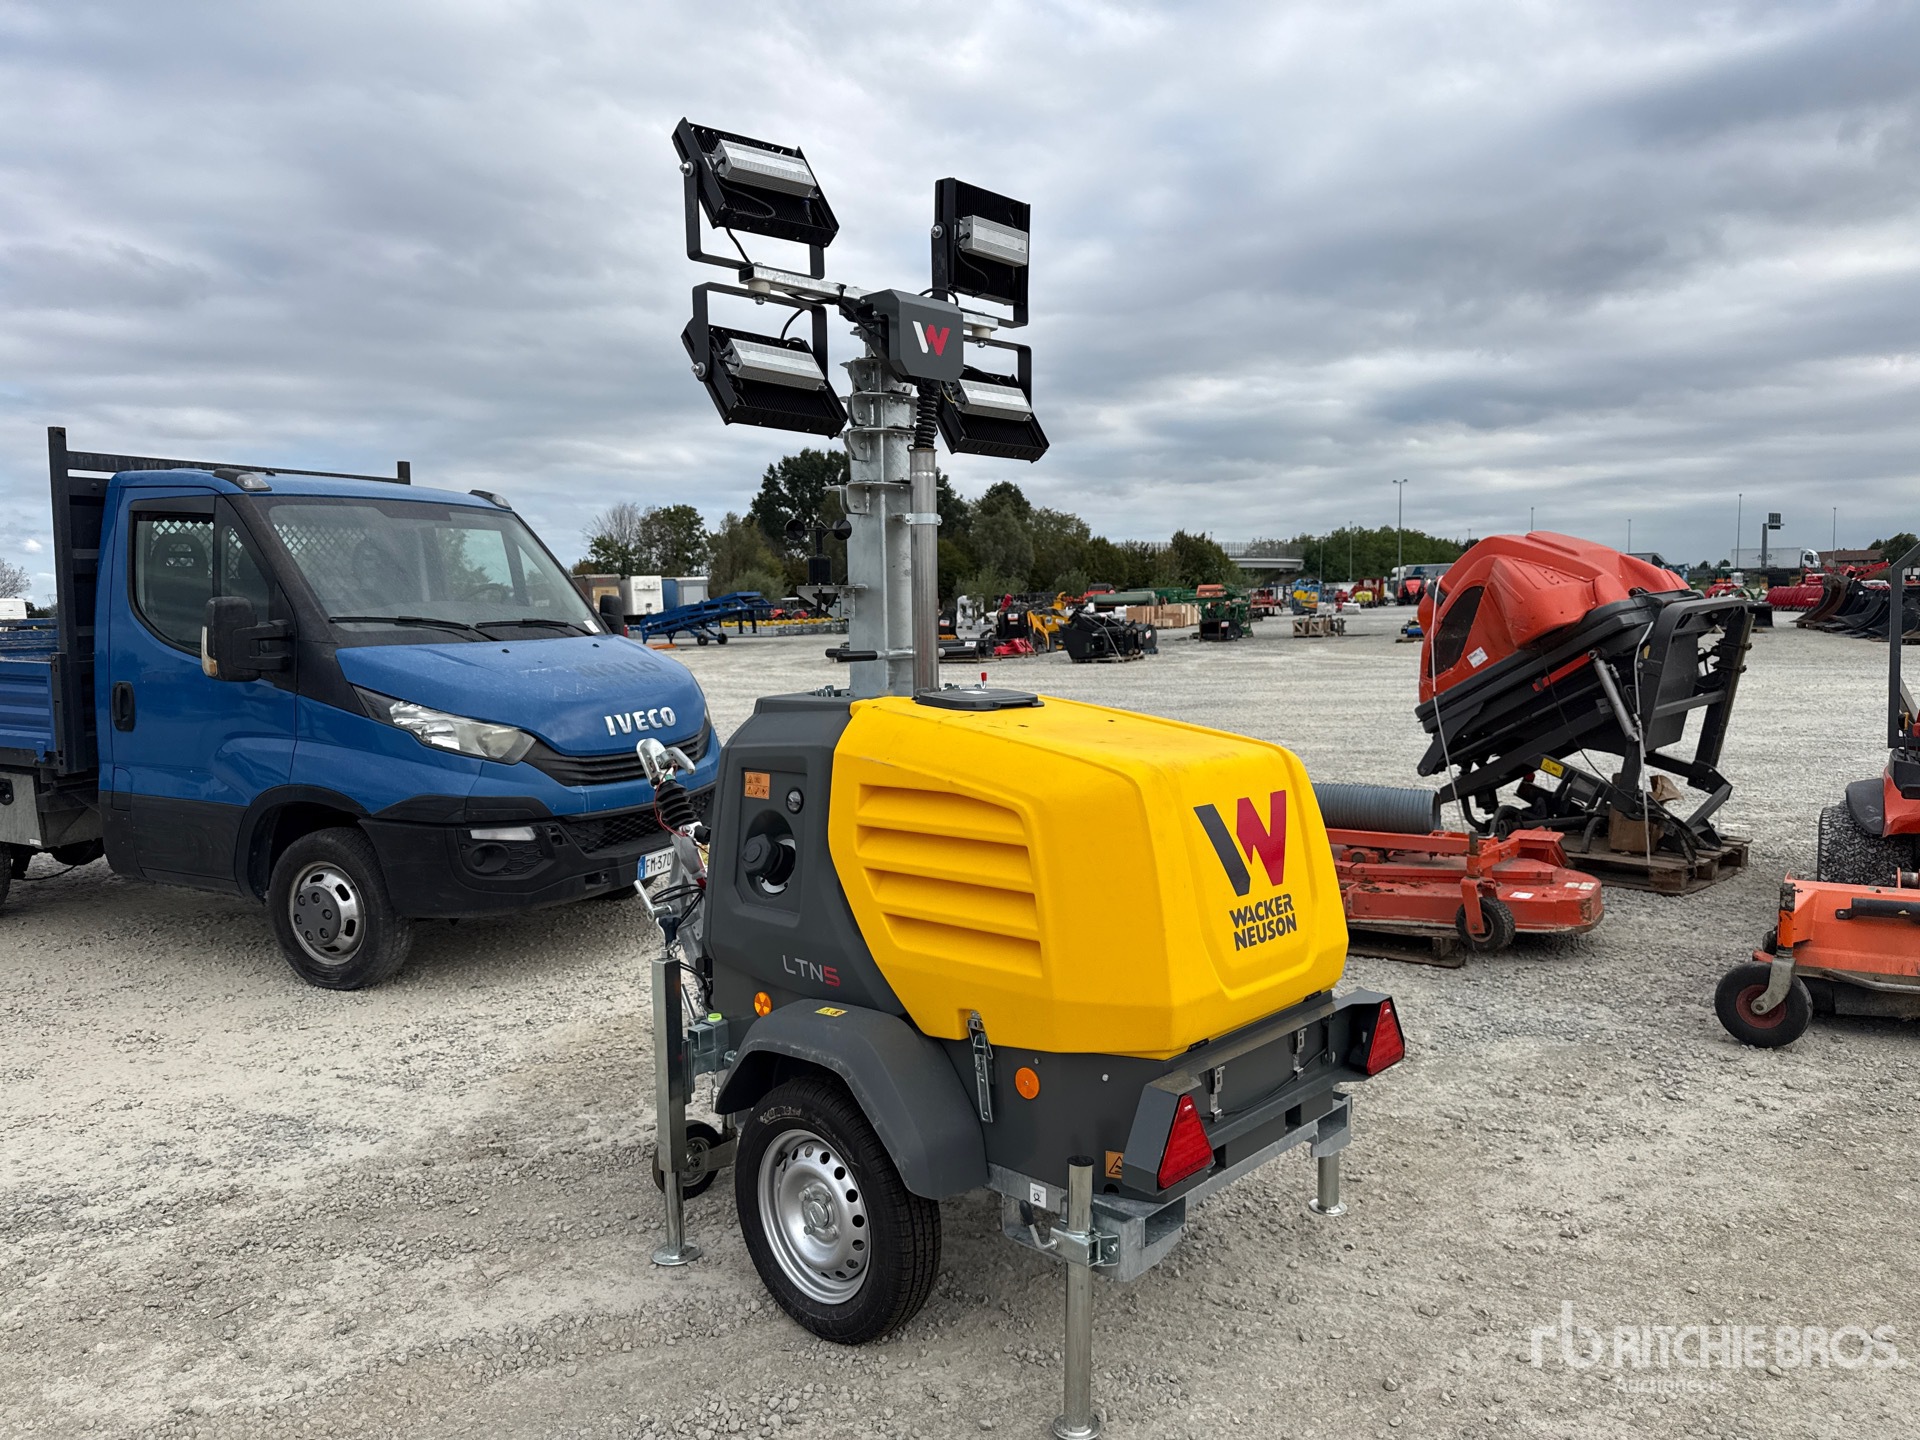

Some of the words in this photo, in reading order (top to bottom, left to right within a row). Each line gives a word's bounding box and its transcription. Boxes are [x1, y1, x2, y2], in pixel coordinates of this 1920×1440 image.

[603, 706, 677, 736] IVECO
[1229, 893, 1295, 929] WACKER
[1233, 913, 1298, 951] NEUSON
[782, 954, 841, 987] LTN5
